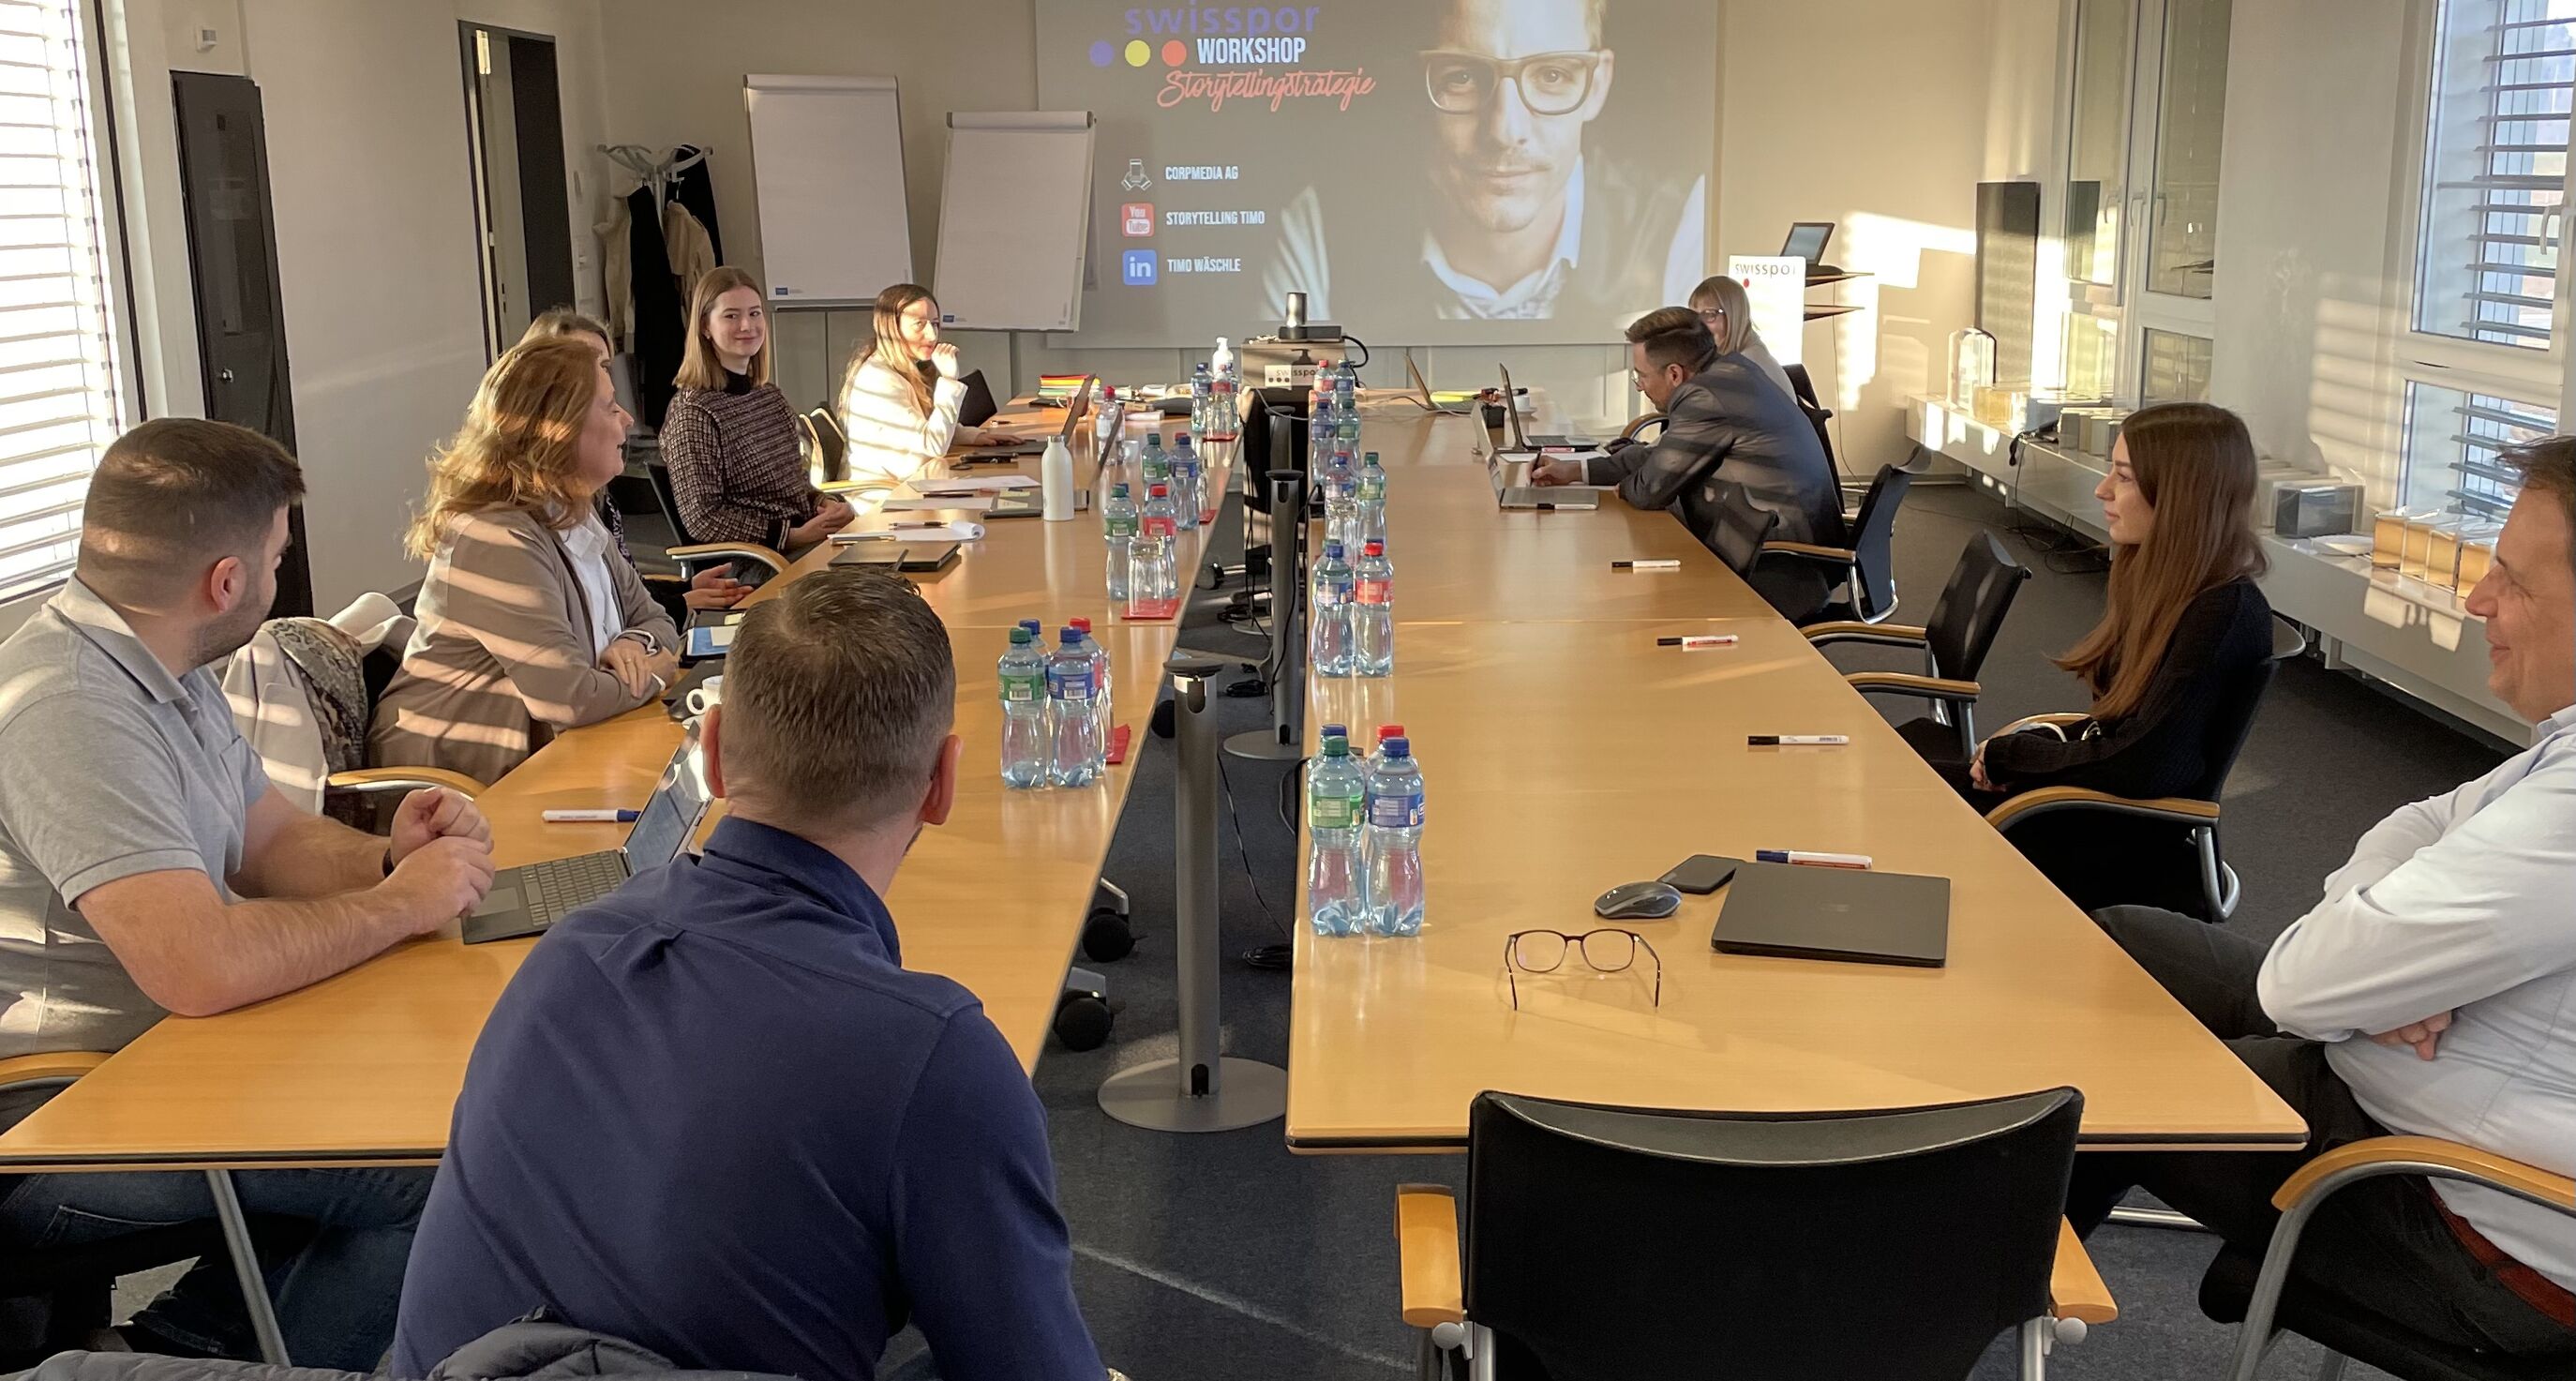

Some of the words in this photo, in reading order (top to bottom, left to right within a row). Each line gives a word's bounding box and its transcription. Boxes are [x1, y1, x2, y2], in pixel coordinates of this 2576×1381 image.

[1125, 0, 1320, 37] swisspor
[1196, 38, 1307, 64] WORKSHOP
[1157, 68, 1377, 113] Storytellingstrategie
[1165, 166, 1223, 180] CORPMEDIA
[1224, 166, 1239, 179] AG
[1166, 211, 1238, 225] STORYTELLING
[1239, 211, 1266, 224] TIMO
[1129, 256, 1152, 278] in
[1167, 259, 1192, 272] TIMO
[1193, 256, 1242, 272] WÄSCHLE
